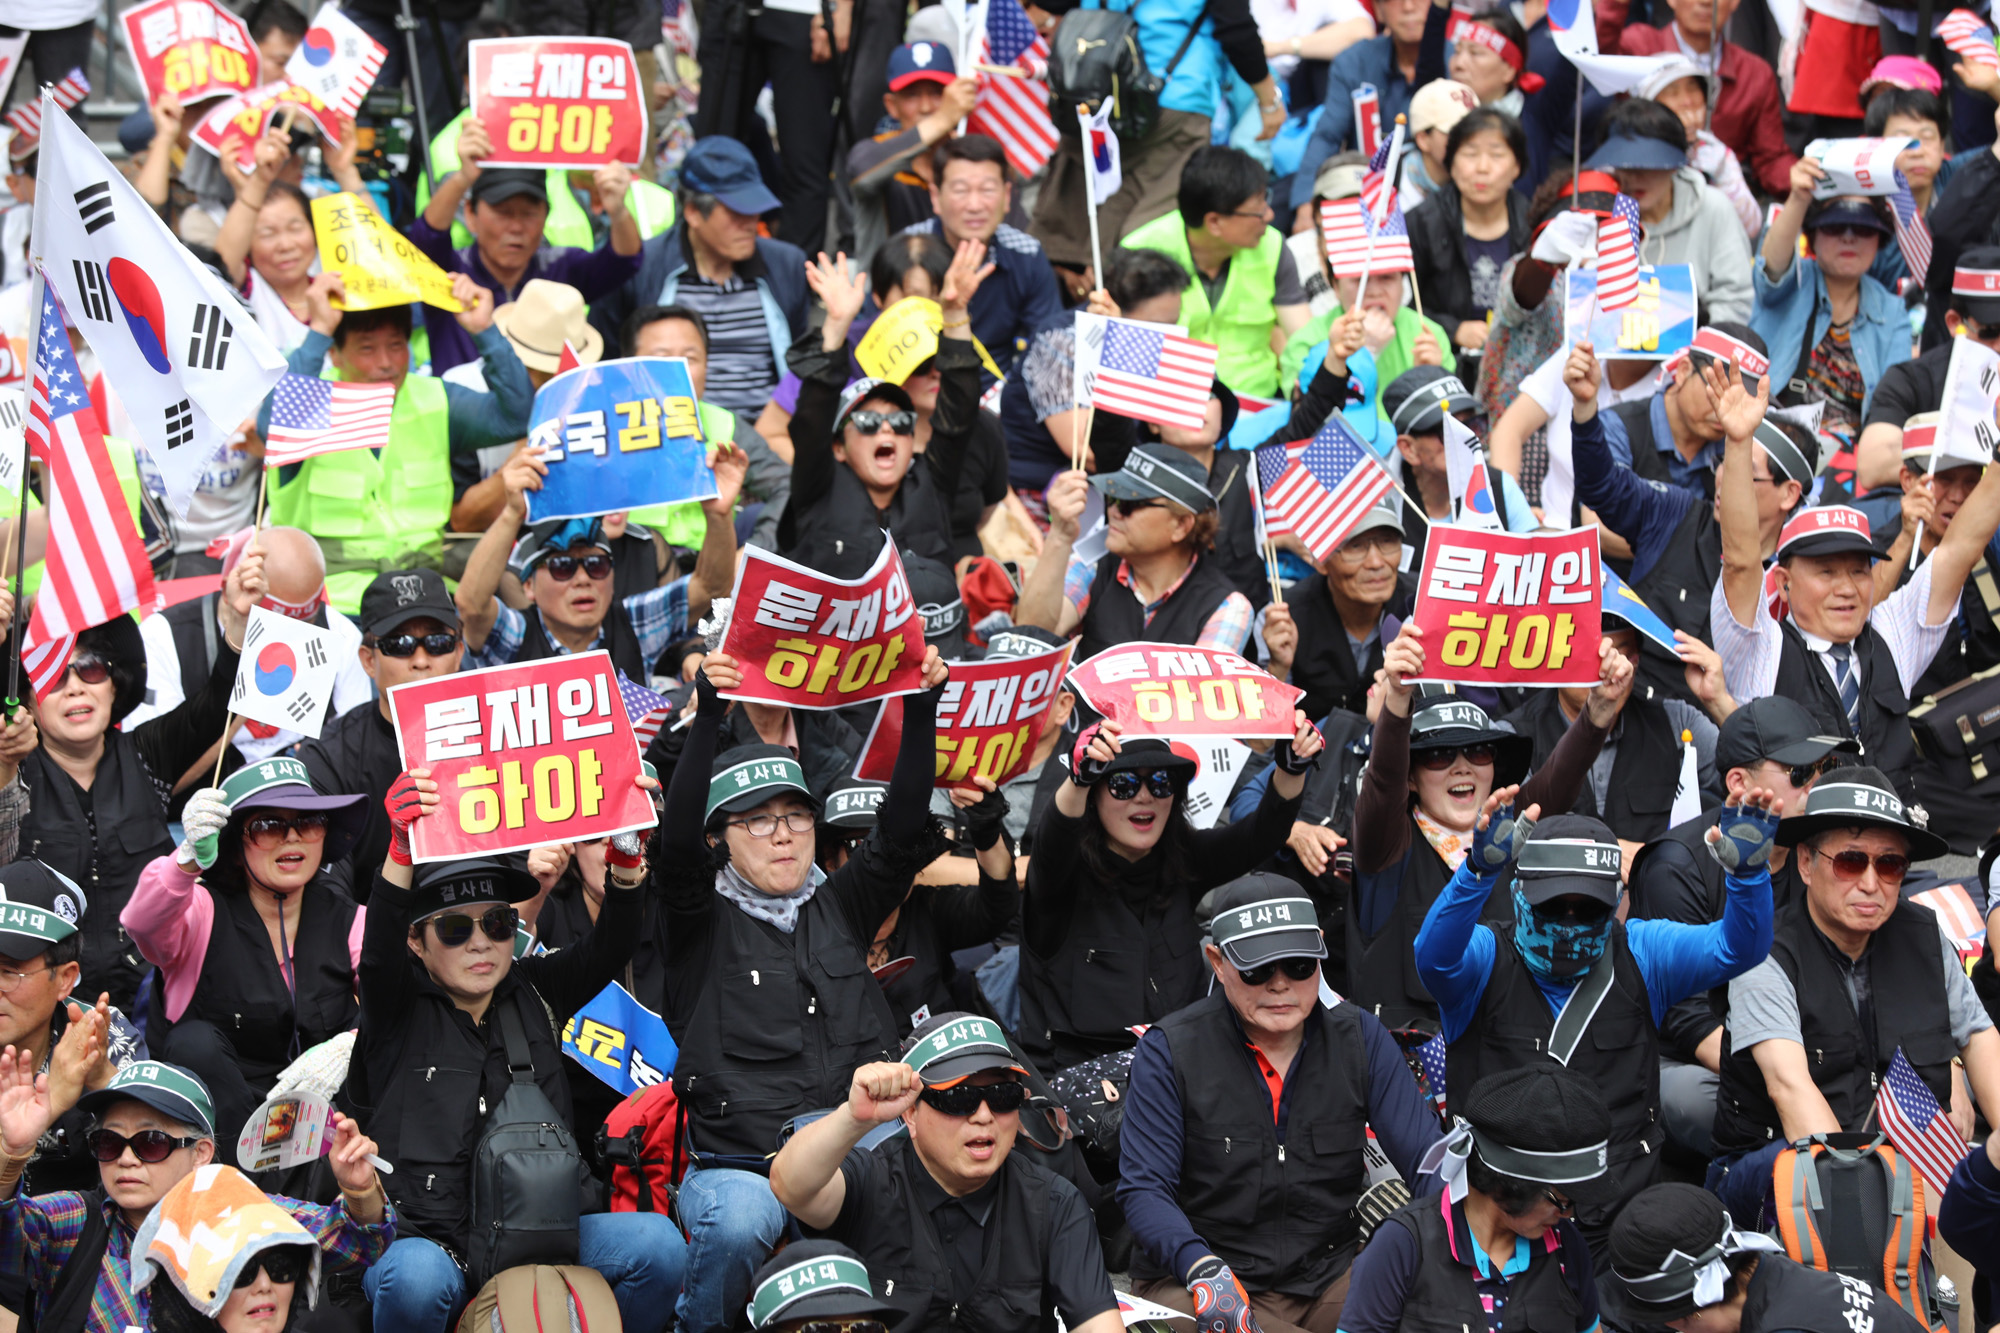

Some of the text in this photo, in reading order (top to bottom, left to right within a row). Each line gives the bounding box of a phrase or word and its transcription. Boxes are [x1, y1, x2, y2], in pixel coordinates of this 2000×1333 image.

[140, 0, 249, 58] 문재인
[163, 41, 251, 93] 하야
[490, 53, 627, 100] 문재인
[507, 102, 614, 154] 하야
[330, 204, 378, 232] 조국
[878, 331, 920, 378] OUT
[614, 395, 704, 453] 감옥
[1816, 511, 1858, 528] 결사대
[1428, 544, 1592, 606] 문재인
[754, 562, 914, 643] 문재인
[997, 637, 1044, 655] 결사대
[1441, 611, 1575, 670] 하야
[765, 633, 906, 694] 하야
[1094, 651, 1274, 684] 문재인
[424, 673, 613, 762] 문재인
[936, 662, 1062, 728] 문재인
[1131, 678, 1265, 722] 하야
[1439, 707, 1483, 727] 결사대
[259, 761, 306, 780] 결사대
[734, 763, 788, 787] 결사대
[936, 724, 1031, 782] 하야
[457, 748, 604, 835] 하야
[836, 793, 884, 811] 결사대
[1853, 790, 1903, 816] 결사대
[440, 880, 495, 902] 결사대
[1239, 904, 1292, 929] 결사대
[931, 1022, 987, 1051] 결사대
[777, 1262, 838, 1297] 결사대
